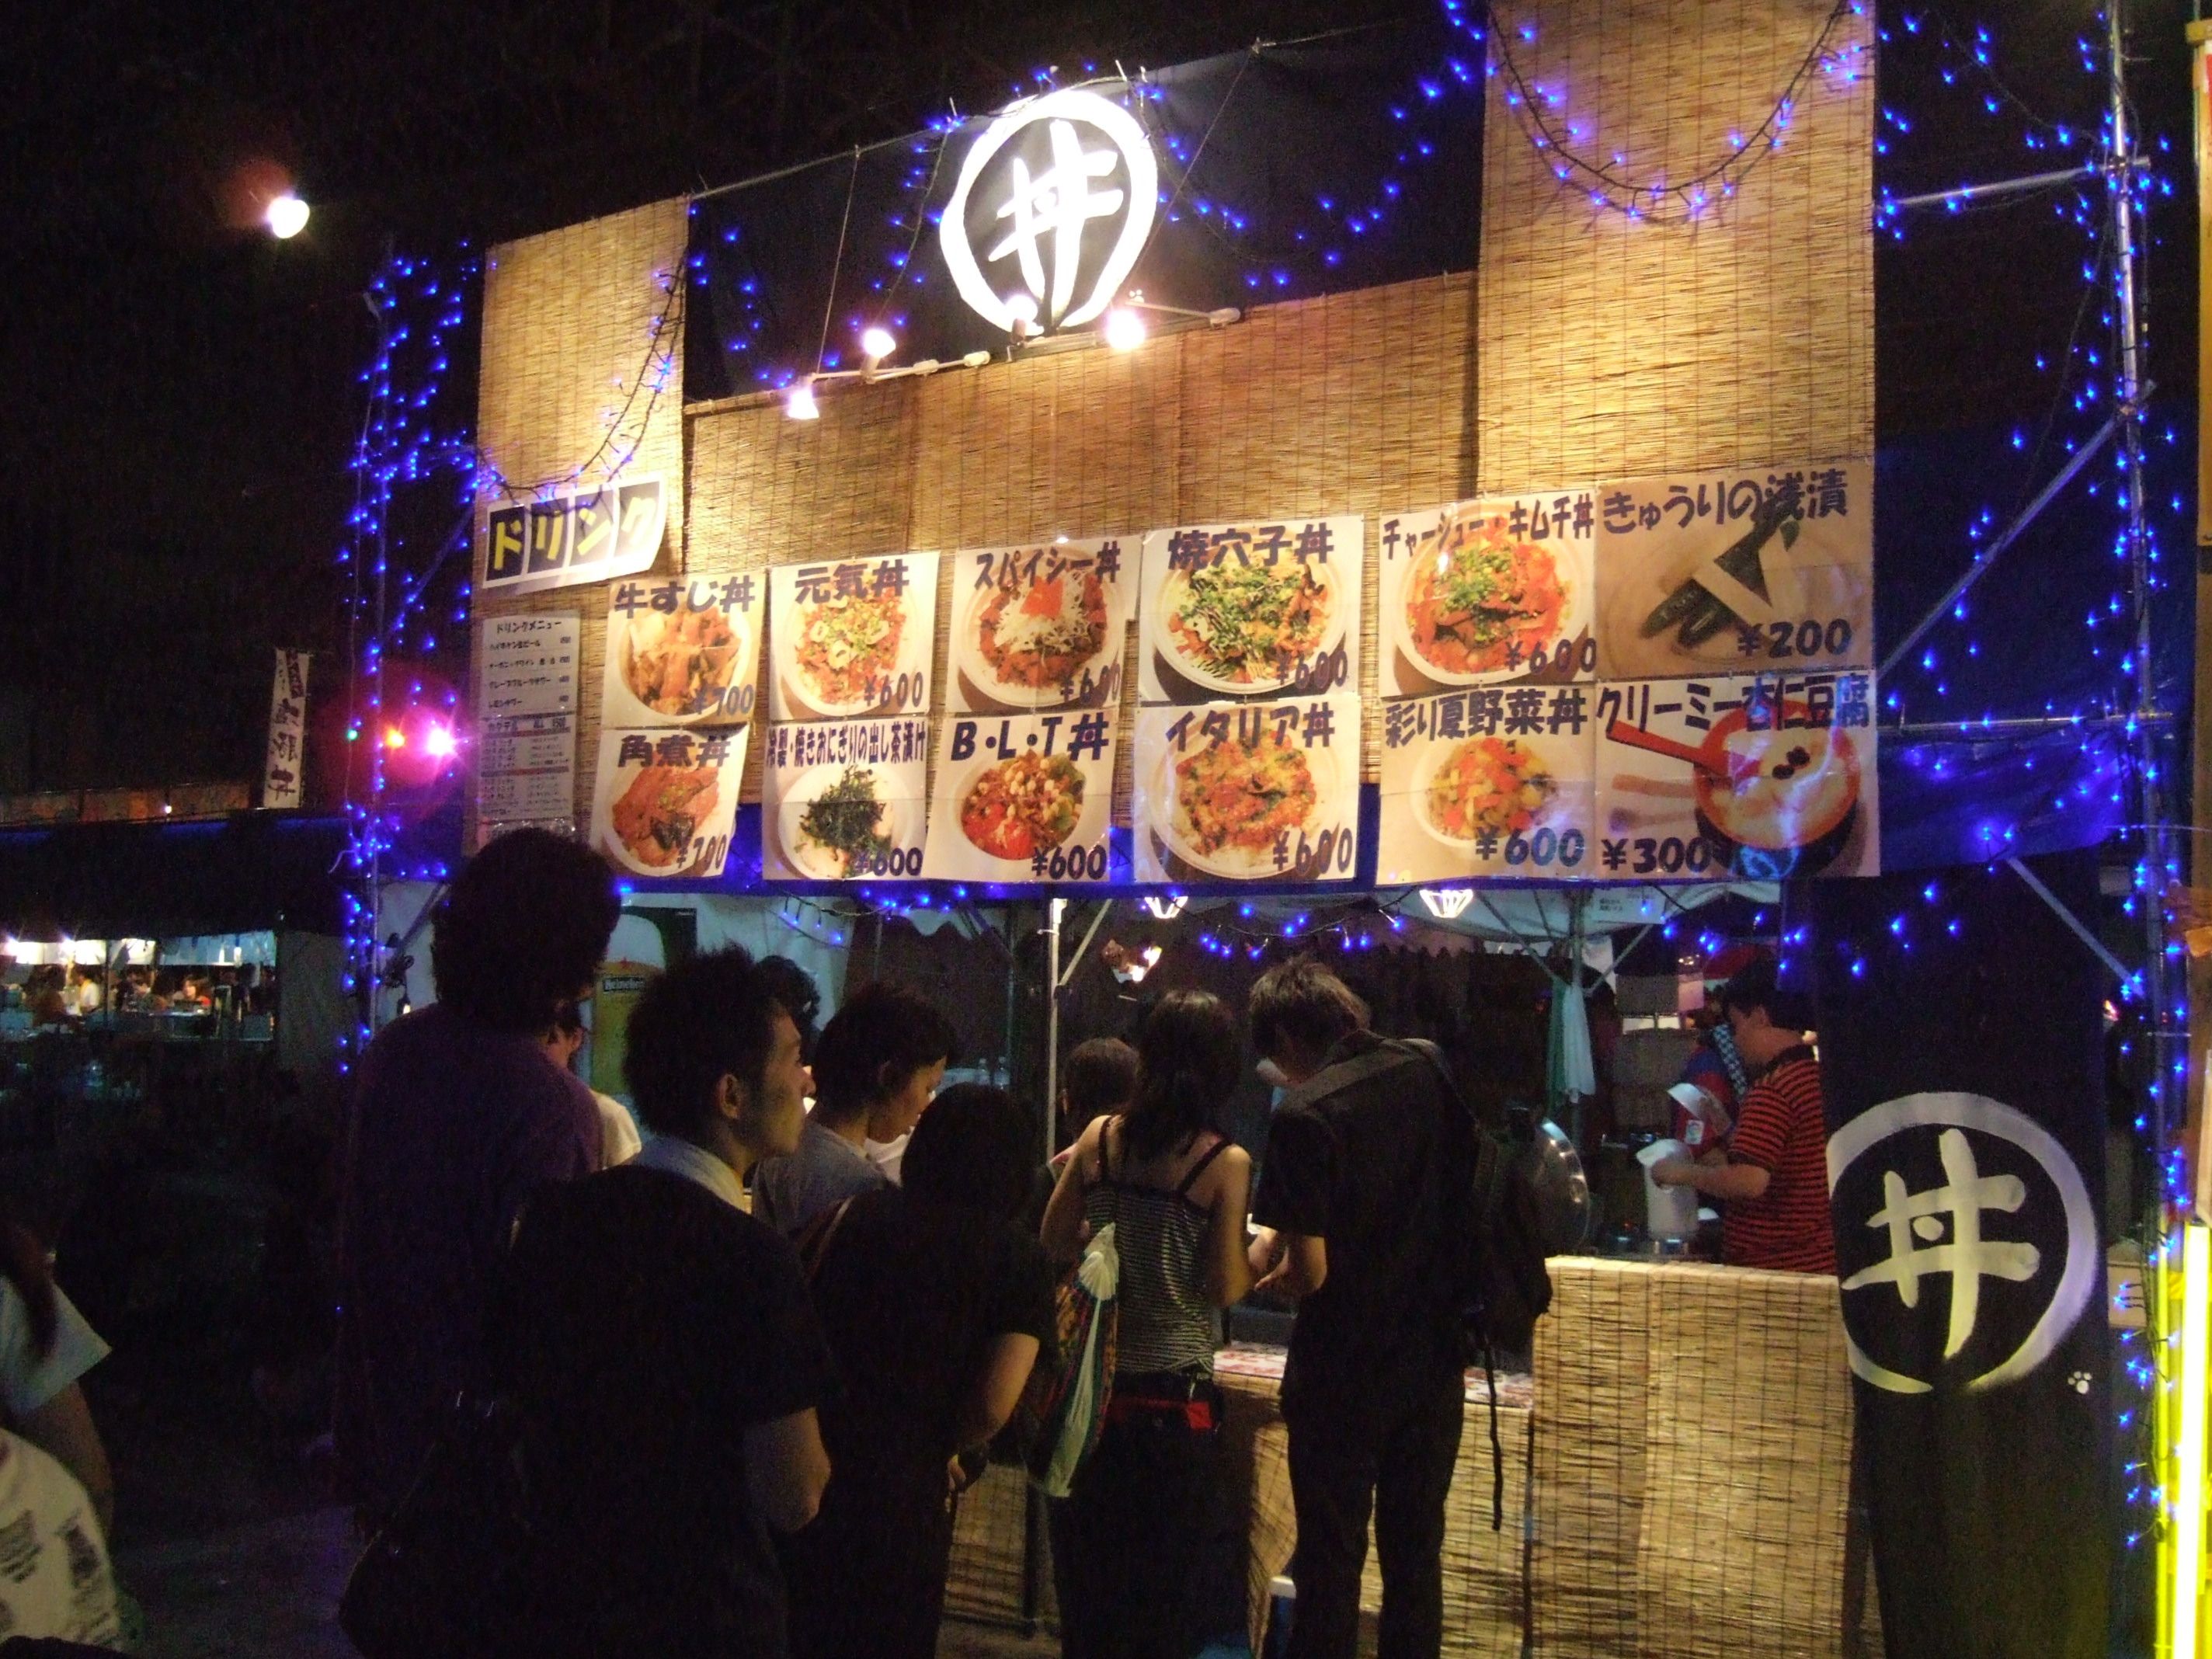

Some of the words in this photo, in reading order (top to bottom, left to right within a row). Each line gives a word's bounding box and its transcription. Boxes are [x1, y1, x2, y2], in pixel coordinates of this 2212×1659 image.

[1603, 468, 1849, 534] きゅうりの浅漬
[493, 495, 659, 572] ドリンク
[1167, 522, 1334, 570] 焼穴子丼
[794, 558, 909, 605] 元気丼
[974, 541, 1122, 590] スパイシー丼
[614, 576, 756, 618] 牛すじ丼
[497, 621, 562, 633] ドリンクメニュー
[1737, 619, 1852, 659] ¥200
[1276, 651, 1348, 687] ¥600
[1505, 638, 1597, 675] ¥600
[691, 683, 754, 716] ¥700
[864, 671, 923, 708] ¥600
[1060, 663, 1122, 702] ¥600
[1166, 701, 1335, 753] イタリア丼
[1386, 688, 1588, 748] 彩り夏野菜丼
[617, 734, 731, 768] 角煮丼
[854, 847, 923, 878] ¥600
[1031, 846, 1107, 881] ¥600
[1271, 826, 1354, 874] ¥600
[1476, 827, 1585, 867] ¥600
[1602, 836, 1709, 874] ¥300
[1841, 1128, 2040, 1359] 丼
